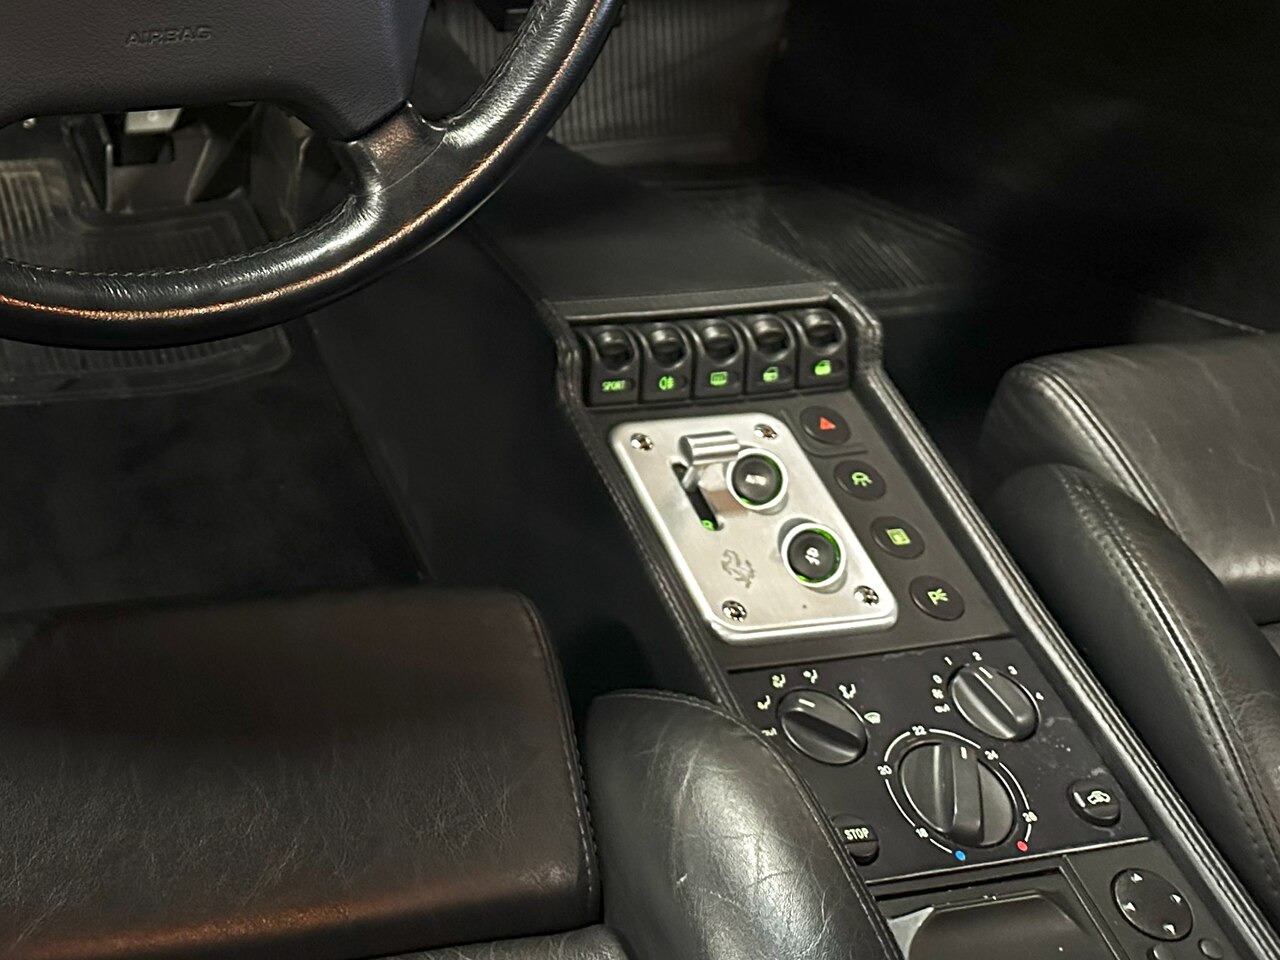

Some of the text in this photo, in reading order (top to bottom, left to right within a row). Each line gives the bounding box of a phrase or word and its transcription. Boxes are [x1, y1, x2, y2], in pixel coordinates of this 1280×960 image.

[125, 26, 213, 47] AIRBAG
[602, 380, 625, 392] SPORT
[944, 656, 952, 665] 1
[972, 651, 982, 661] 2
[1007, 665, 1018, 675] 3
[932, 674, 942, 684] 0
[912, 725, 927, 736] 22
[984, 750, 999, 761] 24
[877, 765, 893, 776] 20
[844, 827, 869, 840] STOP
